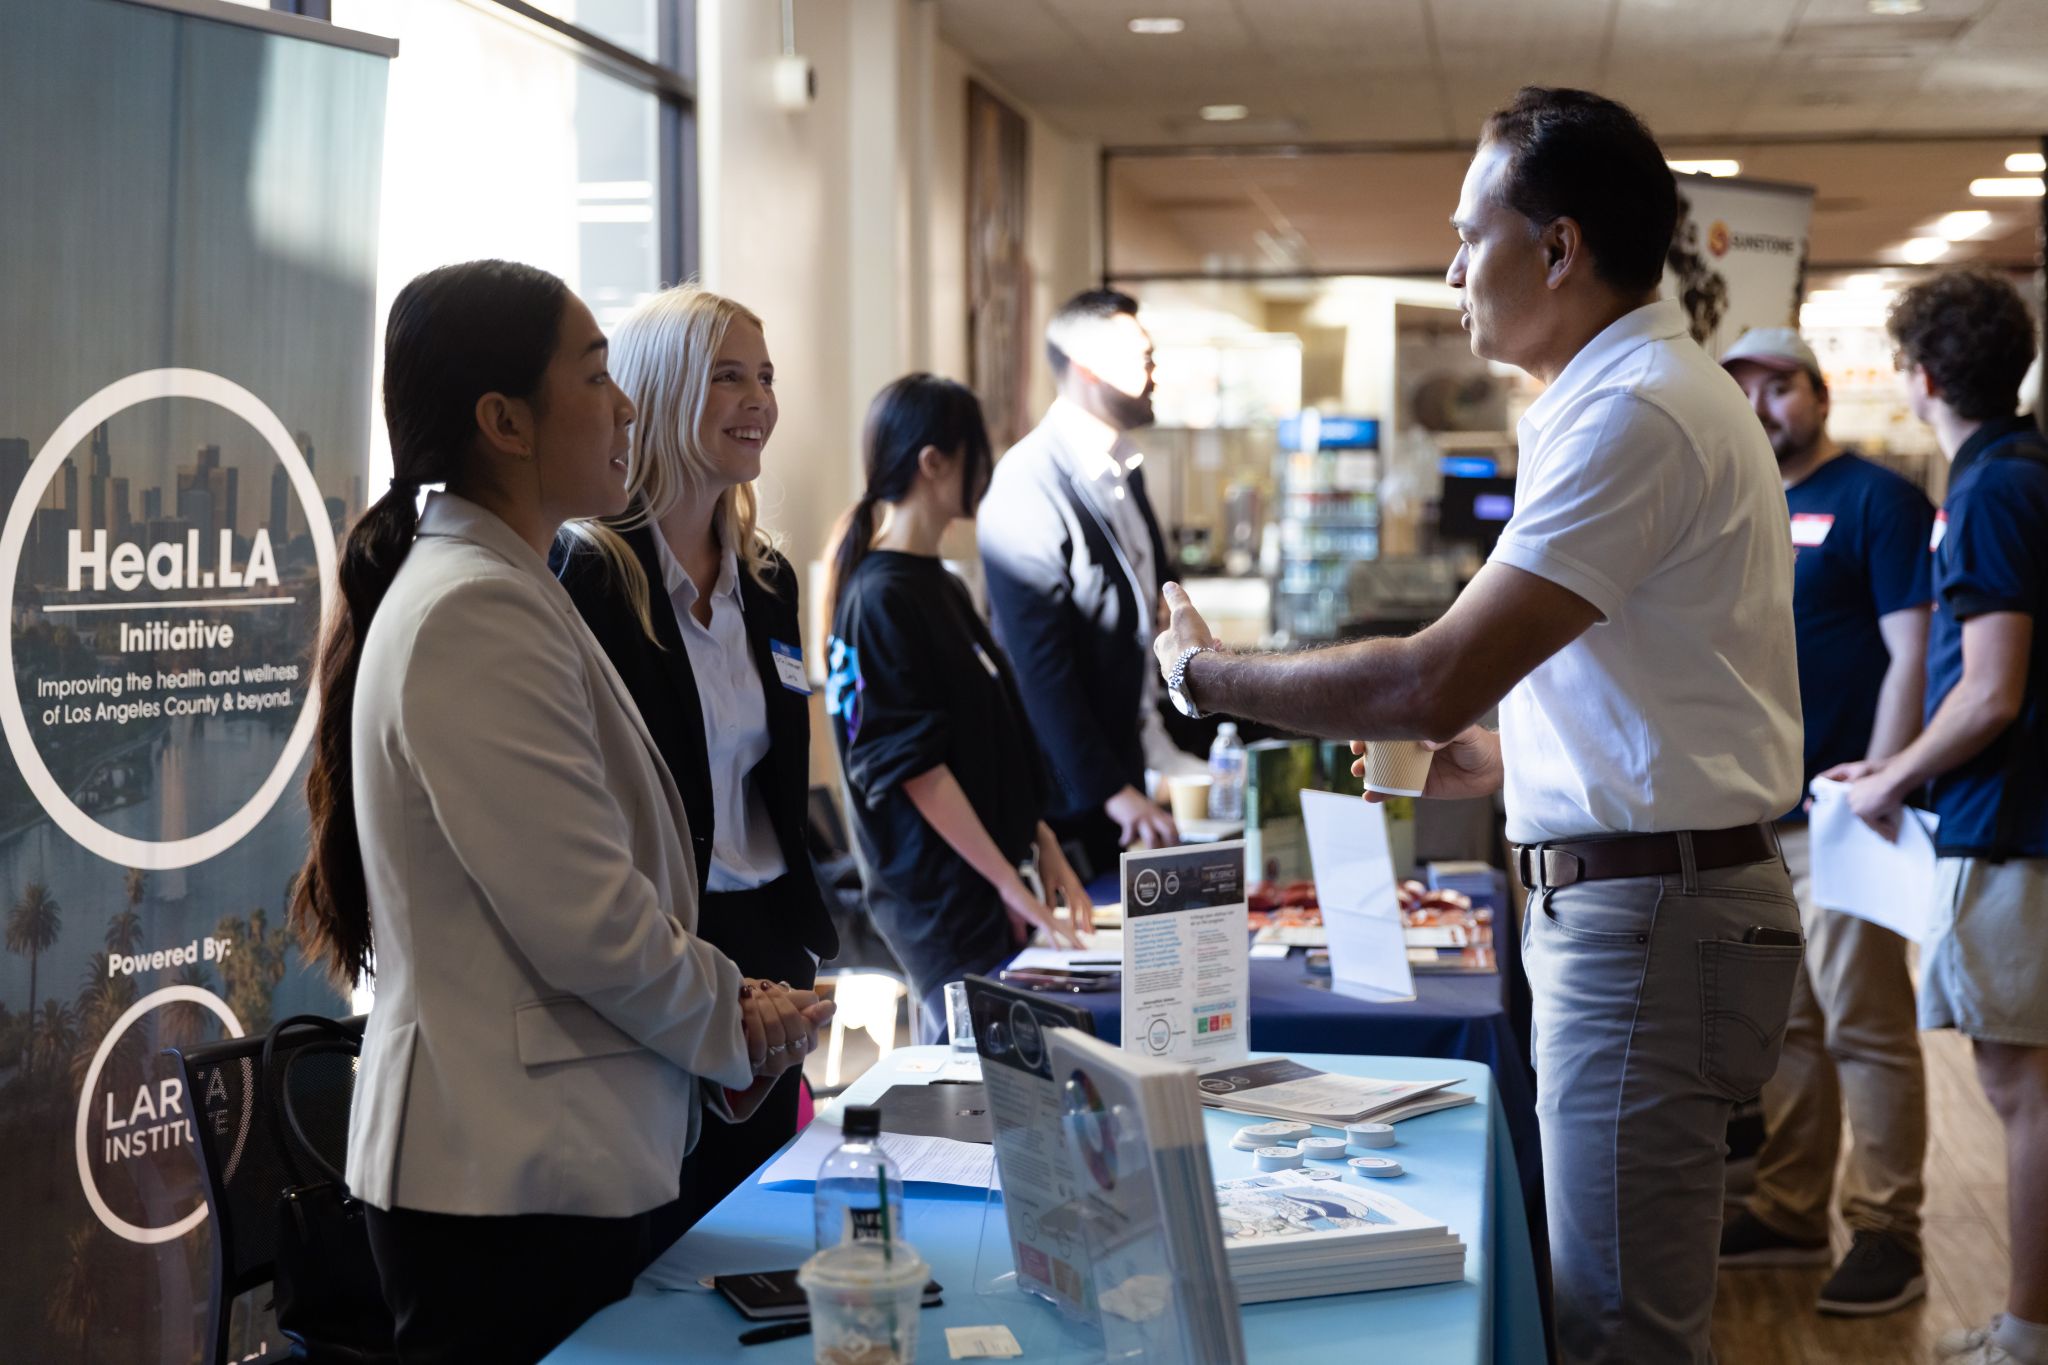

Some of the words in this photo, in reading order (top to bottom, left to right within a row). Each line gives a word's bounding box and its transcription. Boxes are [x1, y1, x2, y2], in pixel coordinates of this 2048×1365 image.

[68, 528, 280, 591] Heal.LA
[120, 619, 234, 653] Initiative
[37, 675, 122, 700] Improving
[126, 672, 152, 691] the
[156, 668, 206, 690] health
[209, 666, 240, 687] and
[243, 663, 299, 683] wellness
[42, 706, 62, 726] of
[64, 704, 92, 724] Los
[95, 699, 161, 725] Angeles
[164, 695, 221, 717] County
[222, 693, 234, 712] &
[237, 688, 294, 713] beyond.
[108, 940, 198, 978] Powered
[203, 937, 231, 963] By:
[107, 1067, 228, 1131] LARA
